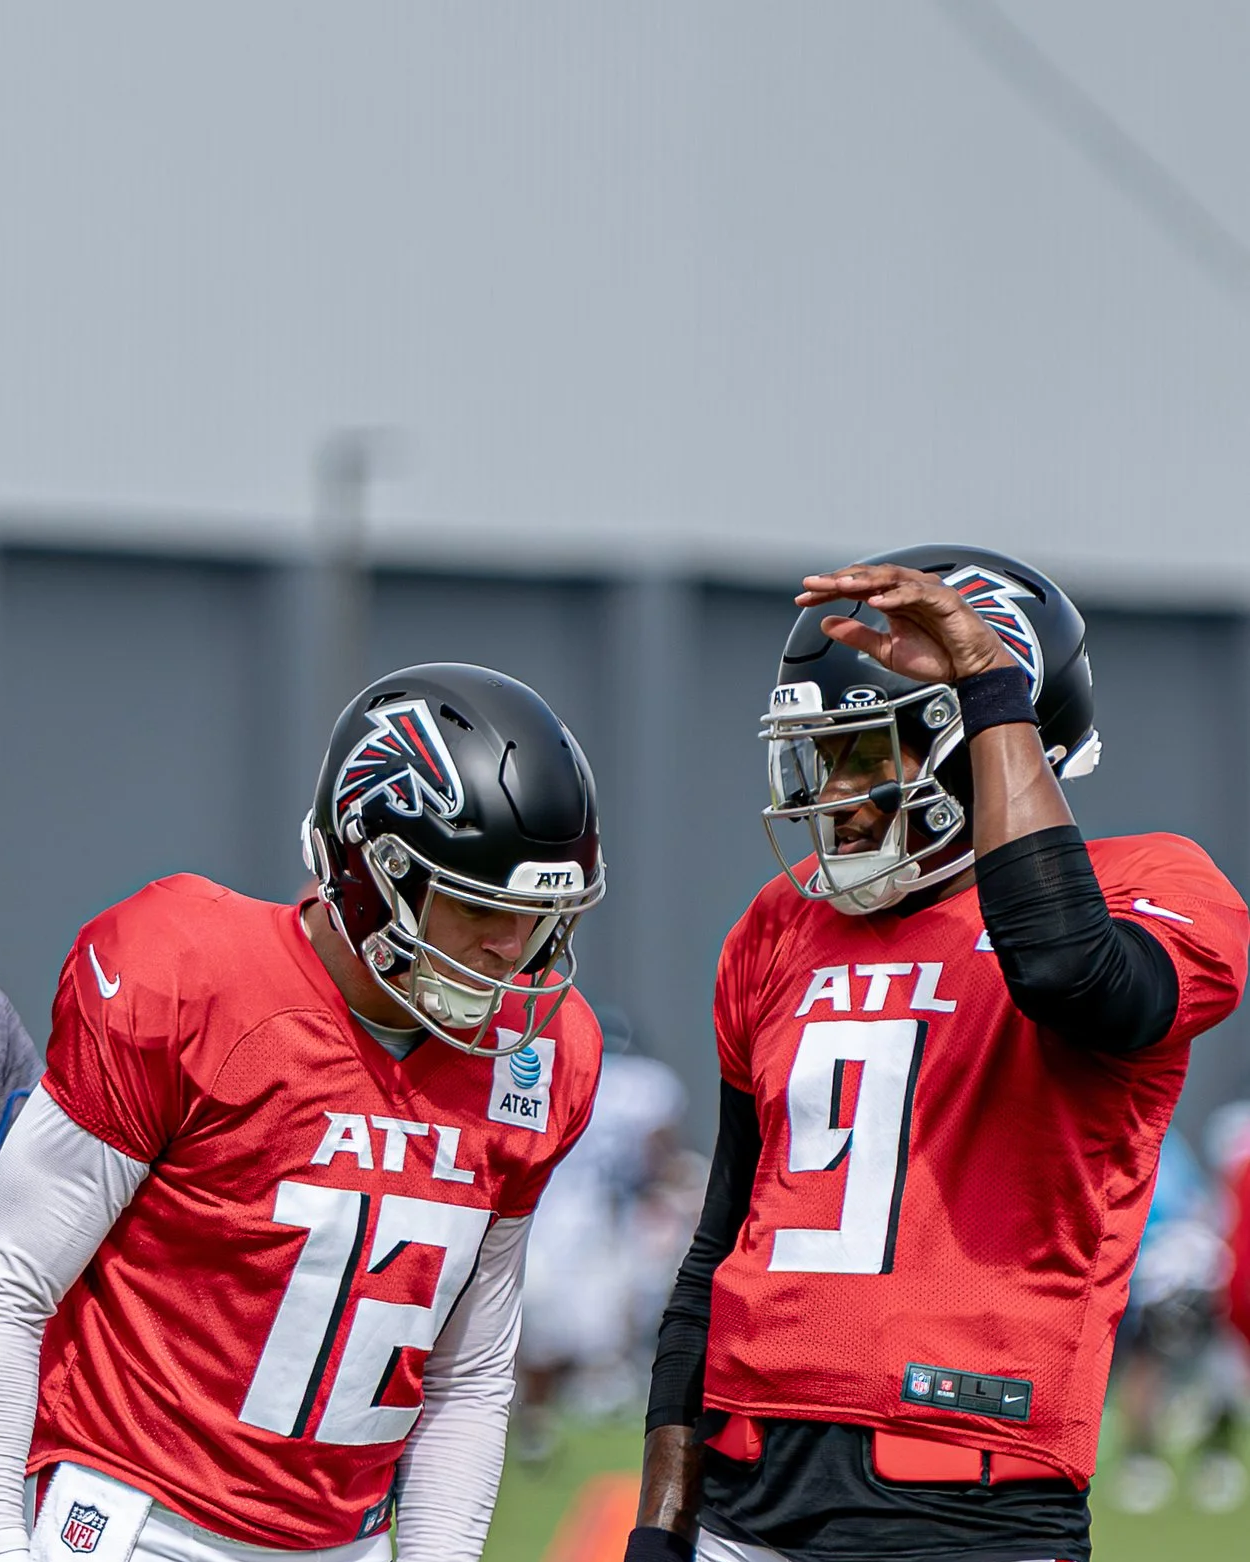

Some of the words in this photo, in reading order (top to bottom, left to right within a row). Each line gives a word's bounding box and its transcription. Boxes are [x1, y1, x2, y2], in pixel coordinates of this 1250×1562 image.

[773, 688, 799, 705] ATL
[534, 872, 574, 889] ATL
[794, 962, 957, 1018] ATL
[499, 1092, 542, 1118] AT&T
[310, 1111, 475, 1184] ATL
[767, 1019, 928, 1275] 9
[237, 1180, 492, 1446] 12
[64, 1520, 95, 1549] NFL
